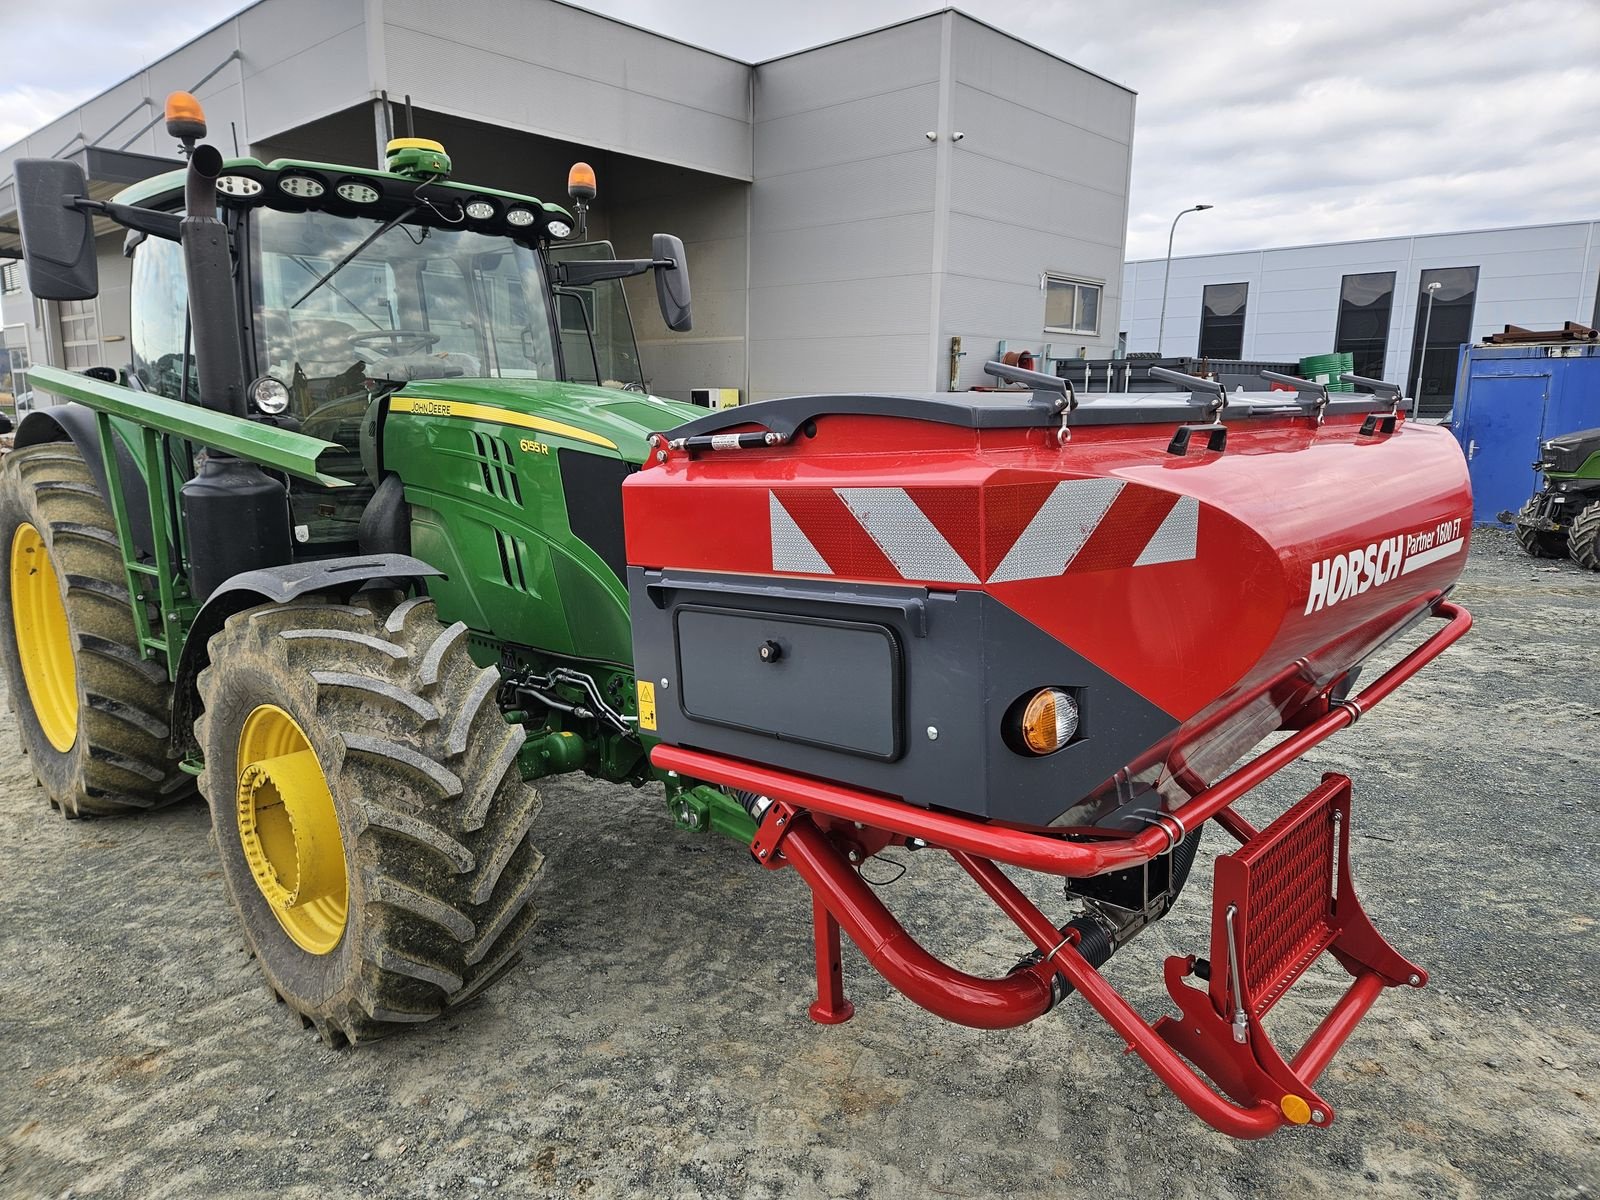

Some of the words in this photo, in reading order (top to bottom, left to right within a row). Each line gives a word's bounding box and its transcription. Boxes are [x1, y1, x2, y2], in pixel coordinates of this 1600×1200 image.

[411, 401, 428, 414] JOHN
[428, 401, 451, 416] DEERE
[520, 439, 540, 453] 6155
[541, 443, 549, 455] R
[1304, 535, 1404, 616] HORSCH
[1406, 531, 1435, 557] Partner
[1436, 520, 1453, 545] 1600
[1452, 517, 1462, 539] FT
